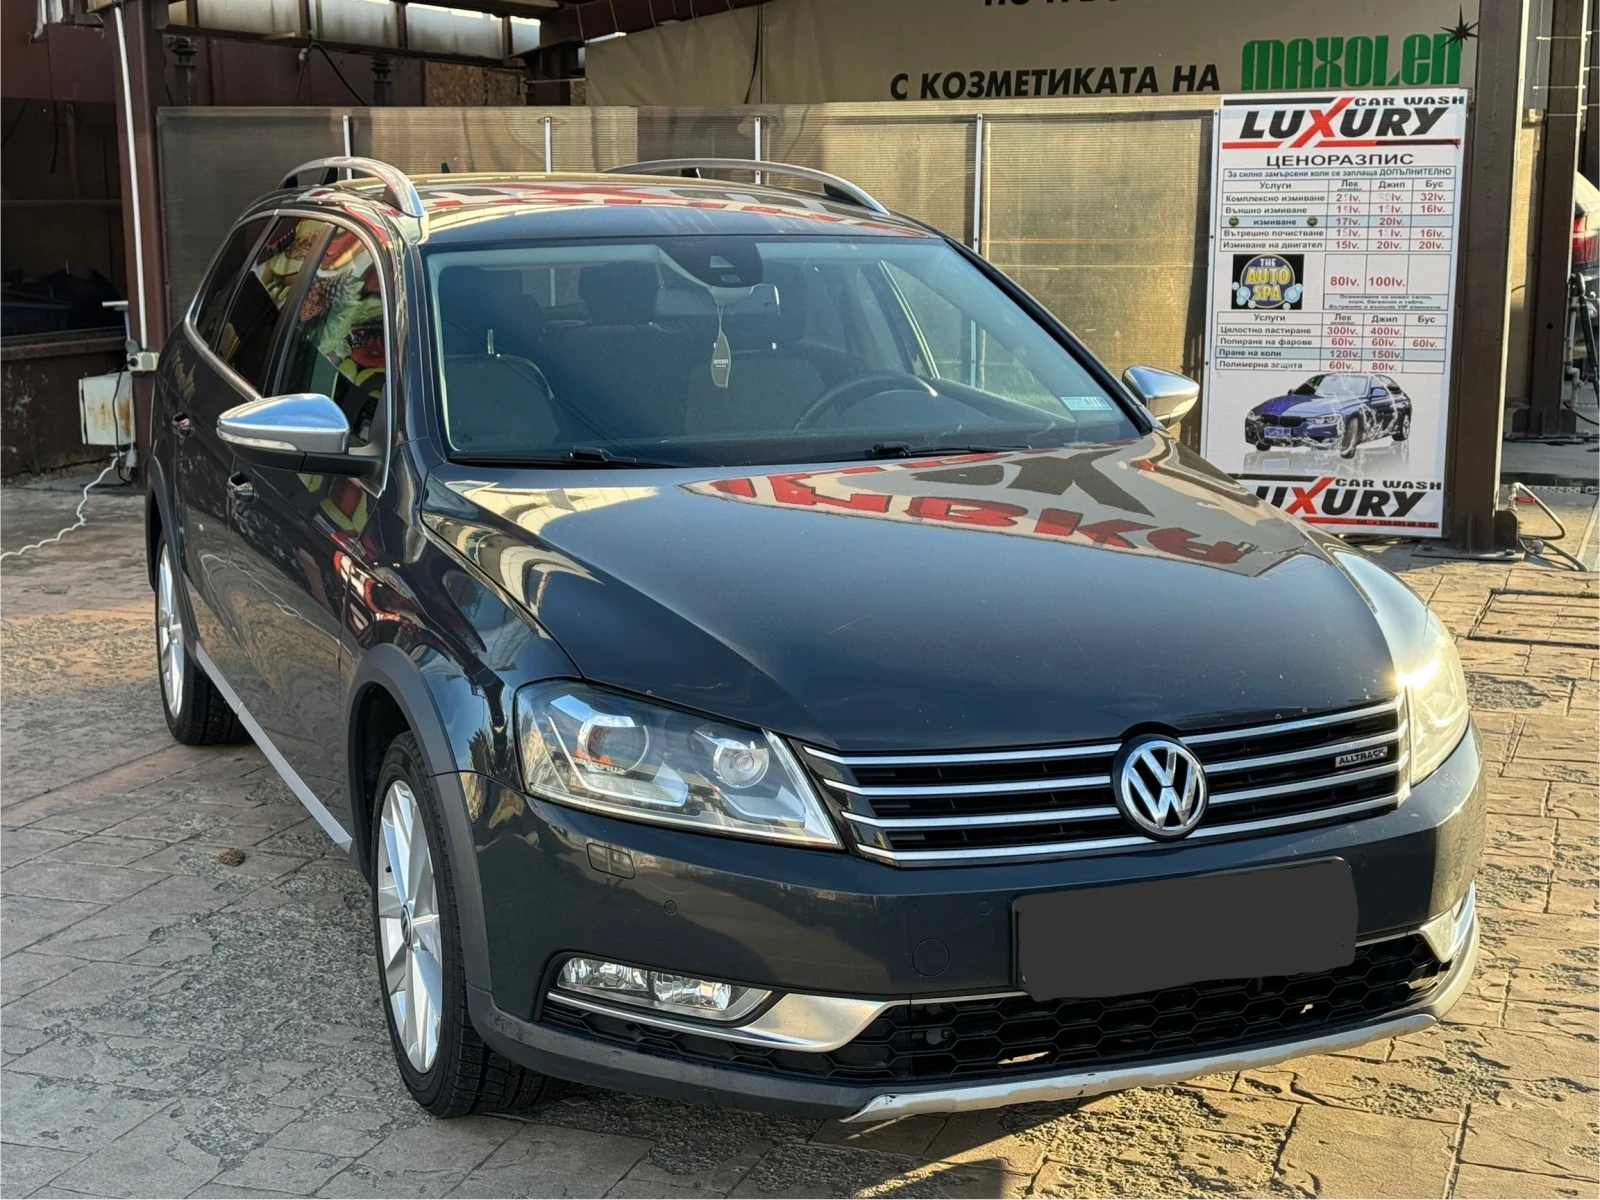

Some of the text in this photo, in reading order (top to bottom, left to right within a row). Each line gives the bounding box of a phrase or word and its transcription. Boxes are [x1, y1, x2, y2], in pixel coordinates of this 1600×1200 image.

[890, 64, 1221, 100] С КОЗМЕТИКАТА НА
[1354, 95, 1464, 107] CAR WASH
[1239, 97, 1449, 148] LUXURY
[1267, 153, 1414, 168] ЦЕНОРАЗПИС
[1227, 170, 1238, 178] За
[1265, 170, 1309, 179] замърсени
[1379, 168, 1452, 177] ДОПЪЛНИТЕЛНО
[1260, 181, 1292, 191] Услуги
[1341, 179, 1359, 188] Лек
[1378, 180, 1405, 190] Джип
[1425, 180, 1444, 190] Бус
[1225, 195, 1279, 203] Комплексно
[1420, 192, 1446, 202] 32lv.
[1225, 206, 1262, 214] Външно
[1420, 204, 1446, 214] 16lv.
[1336, 217, 1361, 226] 17lv.
[1379, 217, 1405, 226] 20lv.
[1224, 230, 1270, 238] Вътрешно
[1420, 229, 1445, 238] 16lv.
[1223, 241, 1266, 249] Измиване
[1281, 242, 1323, 250] двигател
[1335, 241, 1360, 249] 15lv.
[1377, 241, 1402, 249] 20lv.
[1419, 241, 1444, 249] 20lv.
[1260, 258, 1276, 266] THE
[1246, 267, 1291, 285] AUTO
[1330, 276, 1360, 287] 80lv.
[1368, 276, 1406, 288] 100lv.
[1252, 284, 1282, 301] SPA
[1254, 313, 1286, 323] Услуги
[1334, 313, 1352, 321] Лек
[1371, 315, 1398, 324] Джип
[1418, 315, 1436, 325] Бус
[1220, 326, 1311, 335] Цялостно пастиране
[1327, 326, 1358, 335] 300lv.
[1370, 327, 1402, 336] 400lv.
[1220, 338, 1263, 346] Полиране
[1278, 338, 1313, 346] фарове
[1331, 338, 1356, 346] 60lv.
[1371, 338, 1397, 347] 60lv.
[1412, 339, 1438, 348] 60lv.
[1330, 350, 1361, 358] 120lv.
[1372, 350, 1403, 359] 150lv.
[1219, 360, 1269, 368] Полимерна
[1329, 361, 1354, 370] 60lv.
[1372, 362, 1397, 371] 80lv.
[1335, 478, 1442, 490] CAR WASH
[1255, 477, 1428, 517] UXURY
[1338, 748, 1385, 765] ALLTRACK
